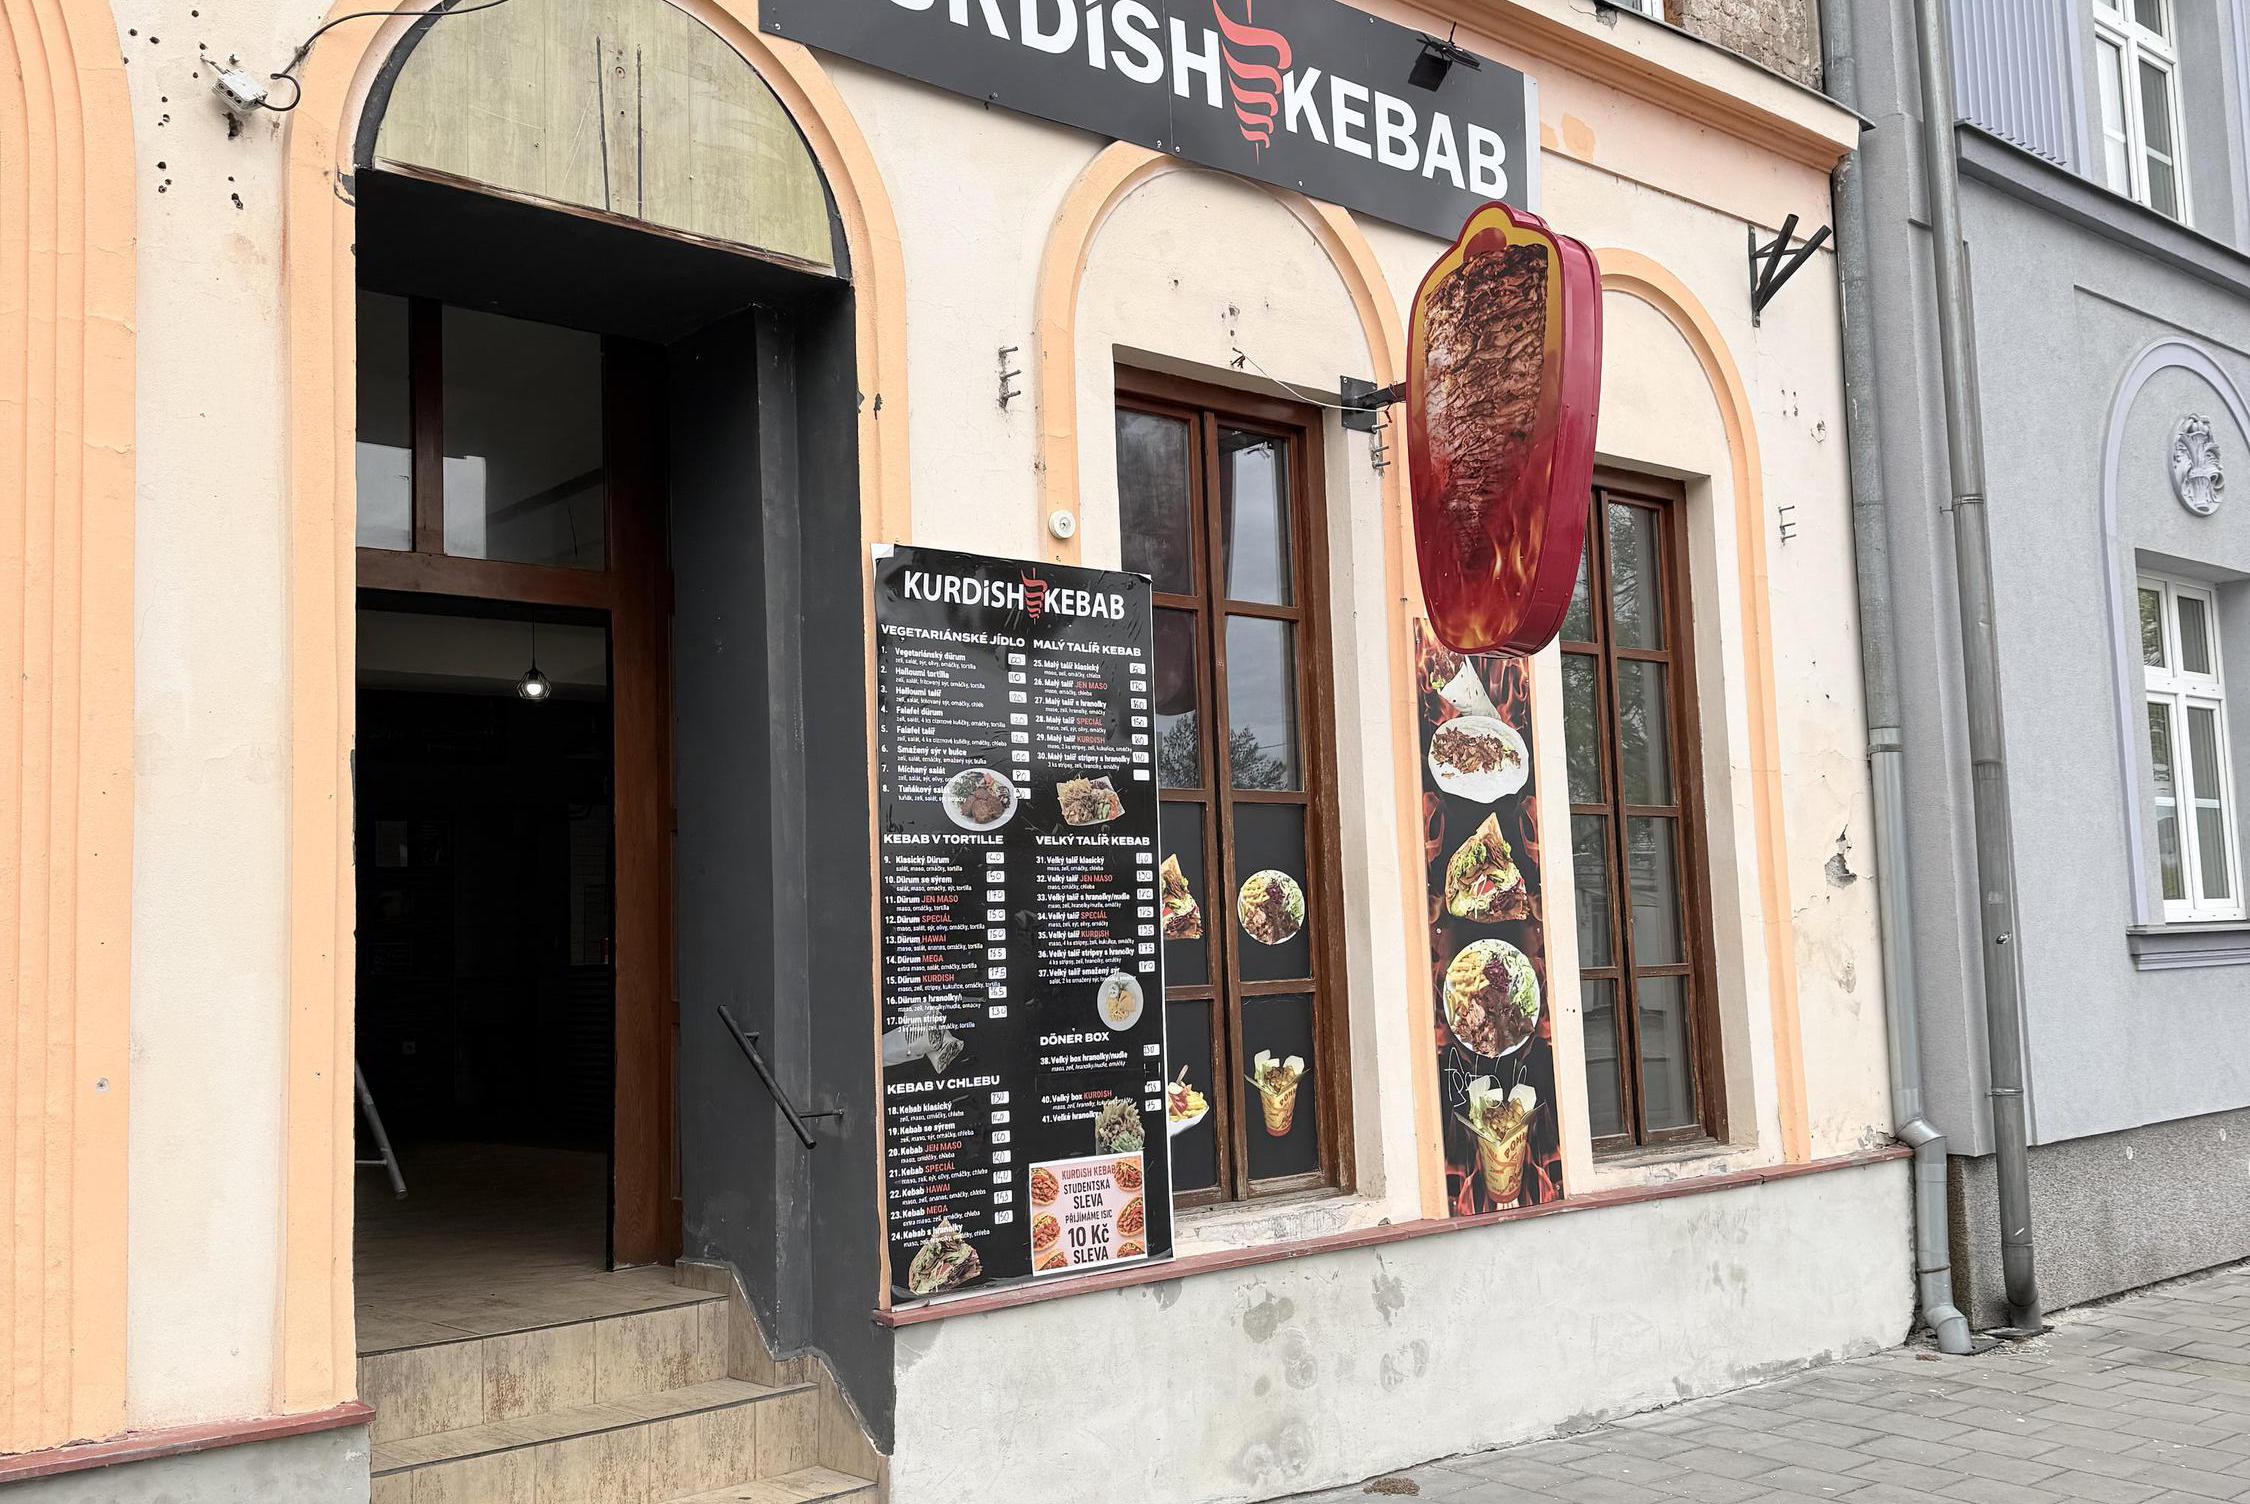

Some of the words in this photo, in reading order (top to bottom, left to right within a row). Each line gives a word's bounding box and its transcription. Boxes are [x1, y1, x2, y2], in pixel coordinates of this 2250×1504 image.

[1283, 67, 1509, 200] KEBAB
[1045, 588, 1125, 620] KEBAB
[881, 624, 987, 643] VEGETARIÁNSKÉ
[990, 633, 1025, 647] JÍDLO
[881, 646, 887, 654] 1.
[1034, 639, 1065, 650] MALÝ
[1067, 642, 1100, 654] TALÍŘ
[1102, 645, 1141, 656] KEBAB
[881, 666, 887, 674] 2.
[1075, 681, 1088, 689] JEN
[1089, 682, 1107, 690] MASO
[881, 705, 888, 713] 4.
[881, 725, 888, 733] 5.
[884, 834, 930, 844] KEBAB
[932, 835, 943, 844] V
[945, 835, 1003, 845] TORTILLE
[1036, 834, 1074, 845] VELKÝ
[1076, 834, 1109, 845] TALÍŘ
[1111, 837, 1150, 845] KEBAB
[937, 895, 958, 903] MASO
[885, 916, 896, 924] 12.
[886, 936, 896, 944] 13.
[922, 954, 943, 963] MEGA
[887, 1017, 898, 1025] 17.
[1040, 1033, 1082, 1046] DÖNER
[1085, 1032, 1109, 1042] BOX
[887, 1081, 933, 1094] KEBAB
[935, 1080, 946, 1090] V
[947, 1075, 1000, 1089] CHLEBU
[888, 1128, 899, 1136] 19.
[925, 1143, 940, 1152] JEN
[941, 1141, 962, 1150] MASO
[889, 1169, 900, 1177] 21.
[890, 1191, 901, 1199] 22.
[1074, 1193, 1103, 1209] SLEVA
[891, 1211, 902, 1219] 23.
[891, 1232, 902, 1241] 24.
[1068, 1226, 1086, 1247] 10
[1074, 1246, 1108, 1264] SLEVA
